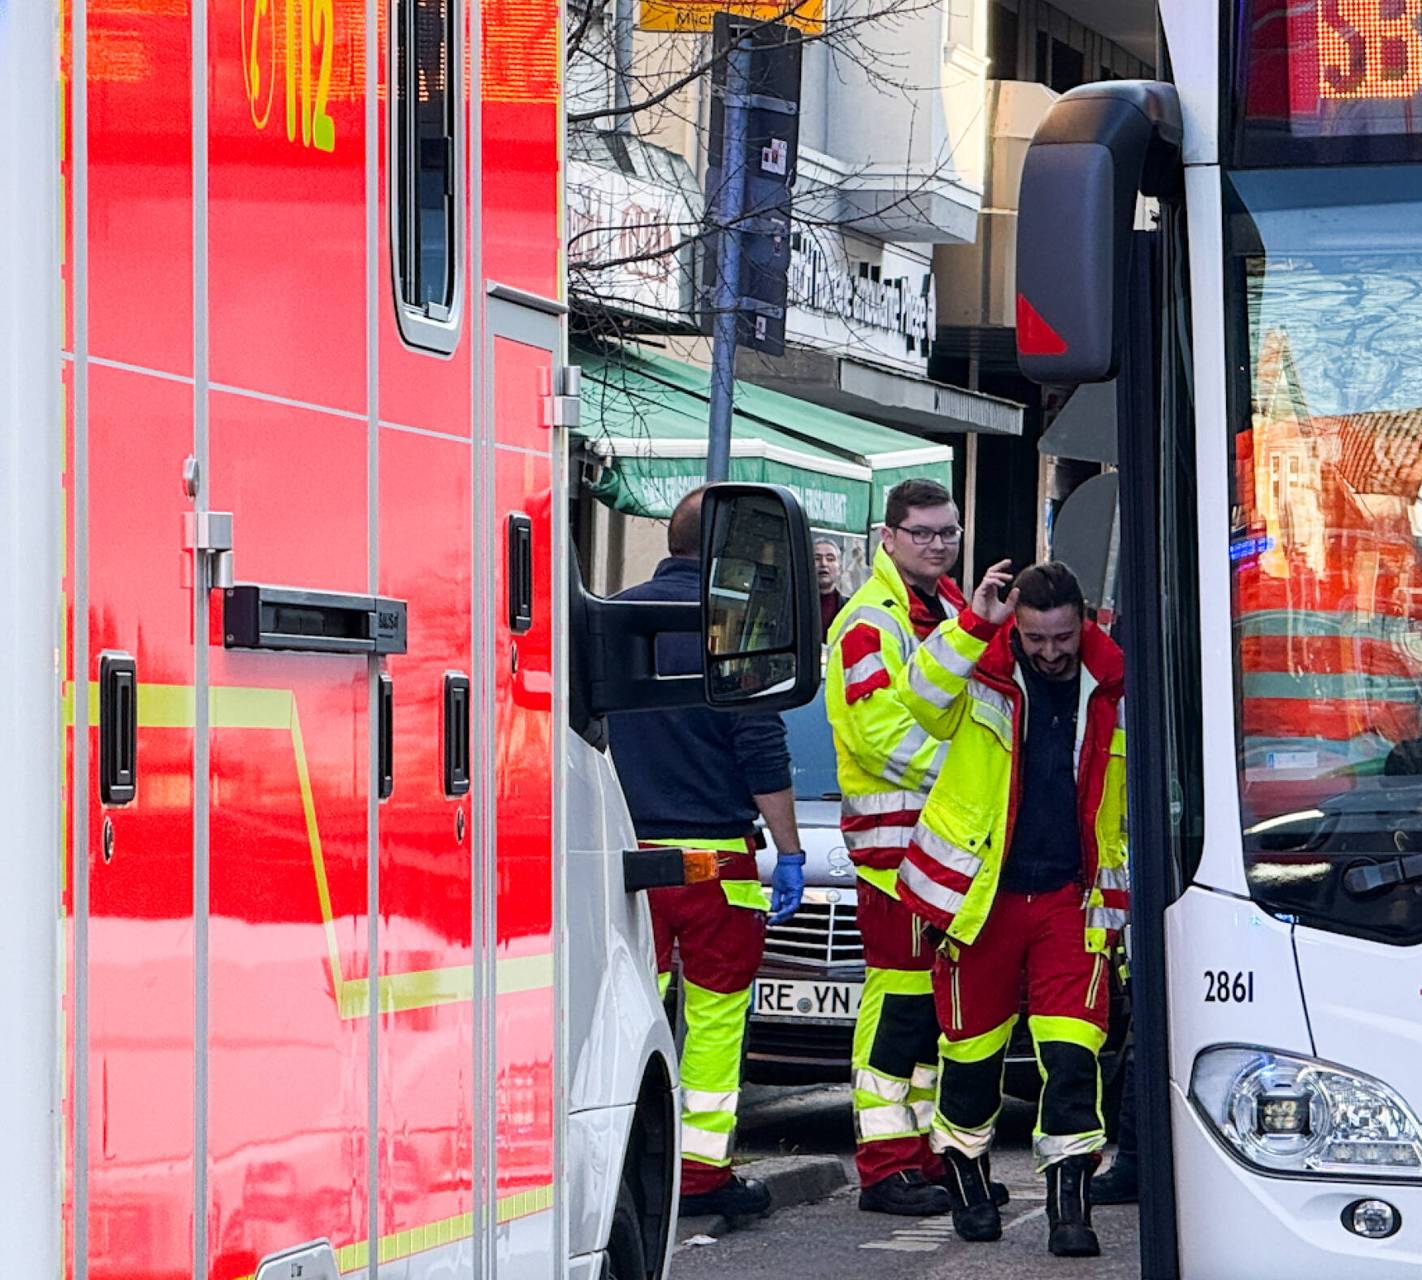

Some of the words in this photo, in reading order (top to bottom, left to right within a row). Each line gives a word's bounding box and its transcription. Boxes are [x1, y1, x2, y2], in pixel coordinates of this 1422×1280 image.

[286, 0, 335, 153] 112
[758, 983, 794, 1011] RE
[813, 985, 850, 1013] YN
[1204, 970, 1254, 1003] 2861
